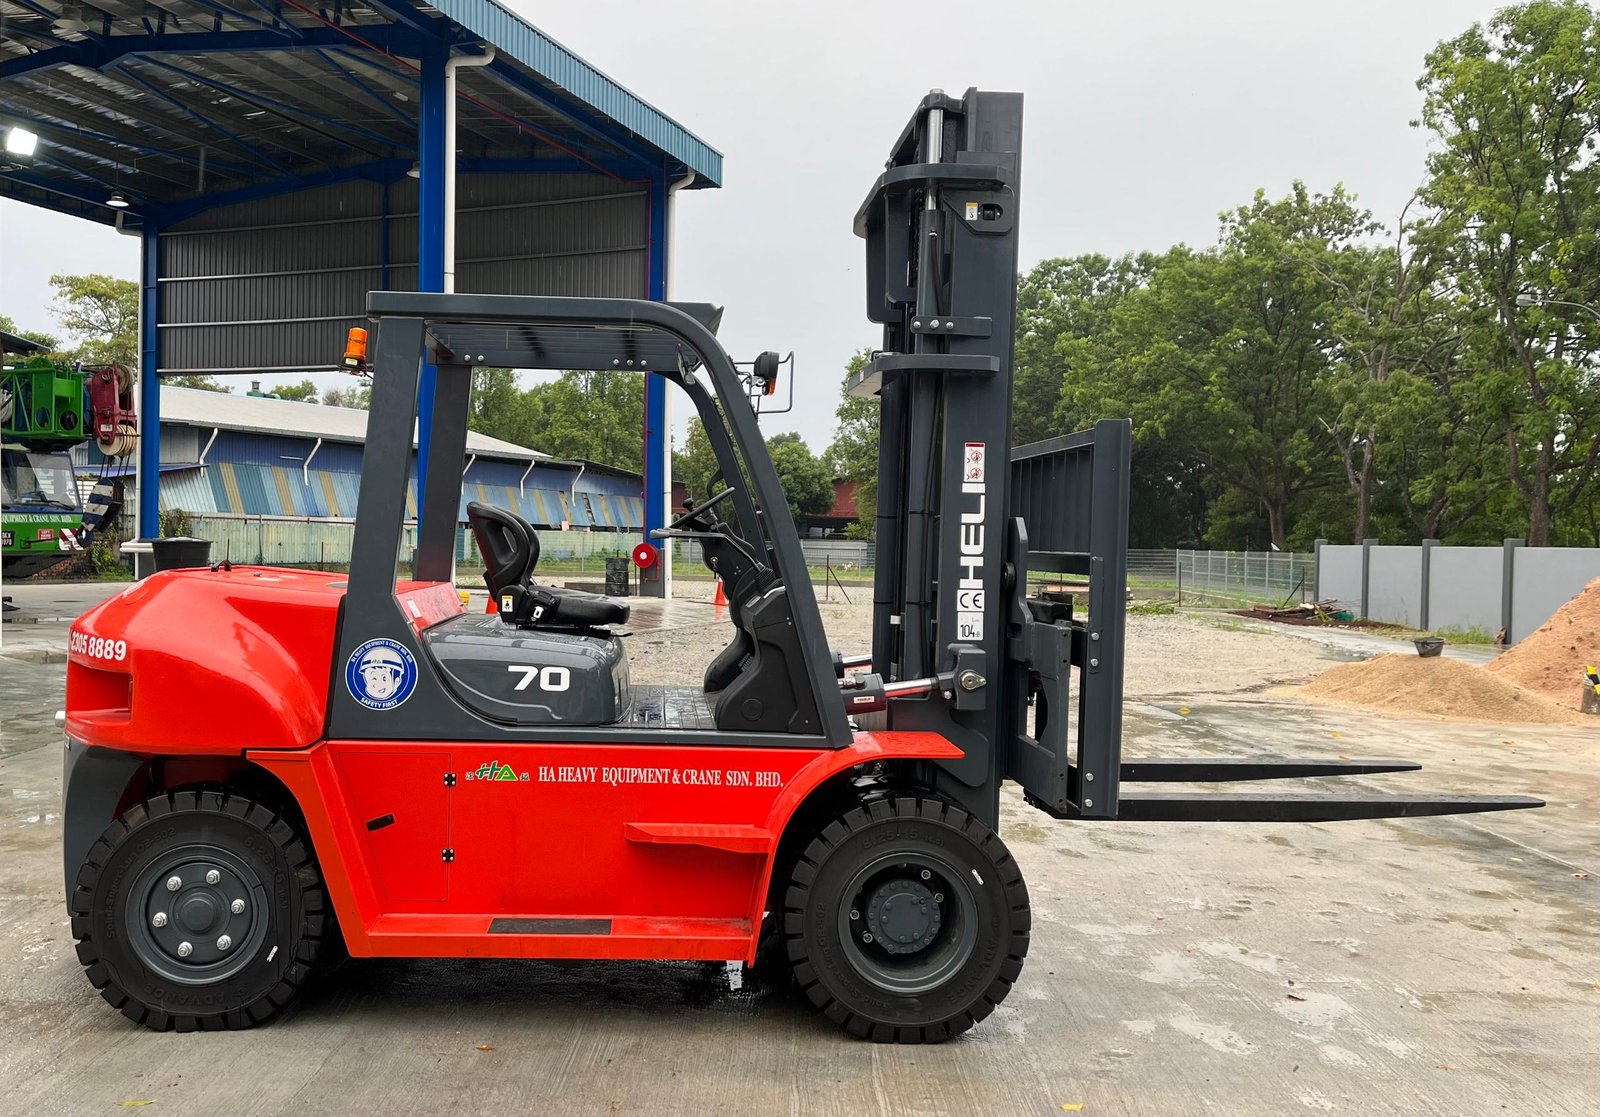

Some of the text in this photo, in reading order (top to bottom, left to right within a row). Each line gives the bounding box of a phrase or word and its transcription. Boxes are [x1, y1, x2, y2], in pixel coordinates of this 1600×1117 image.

[960, 483, 985, 588] HELI
[960, 624, 975, 638] 104
[88, 636, 127, 661] 8889
[508, 665, 570, 691] 70
[361, 698, 398, 708] SAFETY FIRST
[538, 766, 557, 782] HA
[558, 766, 598, 783] HEAVY
[602, 767, 671, 786] EQUIPMENT
[672, 768, 681, 784] &
[682, 769, 721, 785] CRANE
[725, 770, 753, 787] SDN.
[755, 771, 784, 788] BHD.
